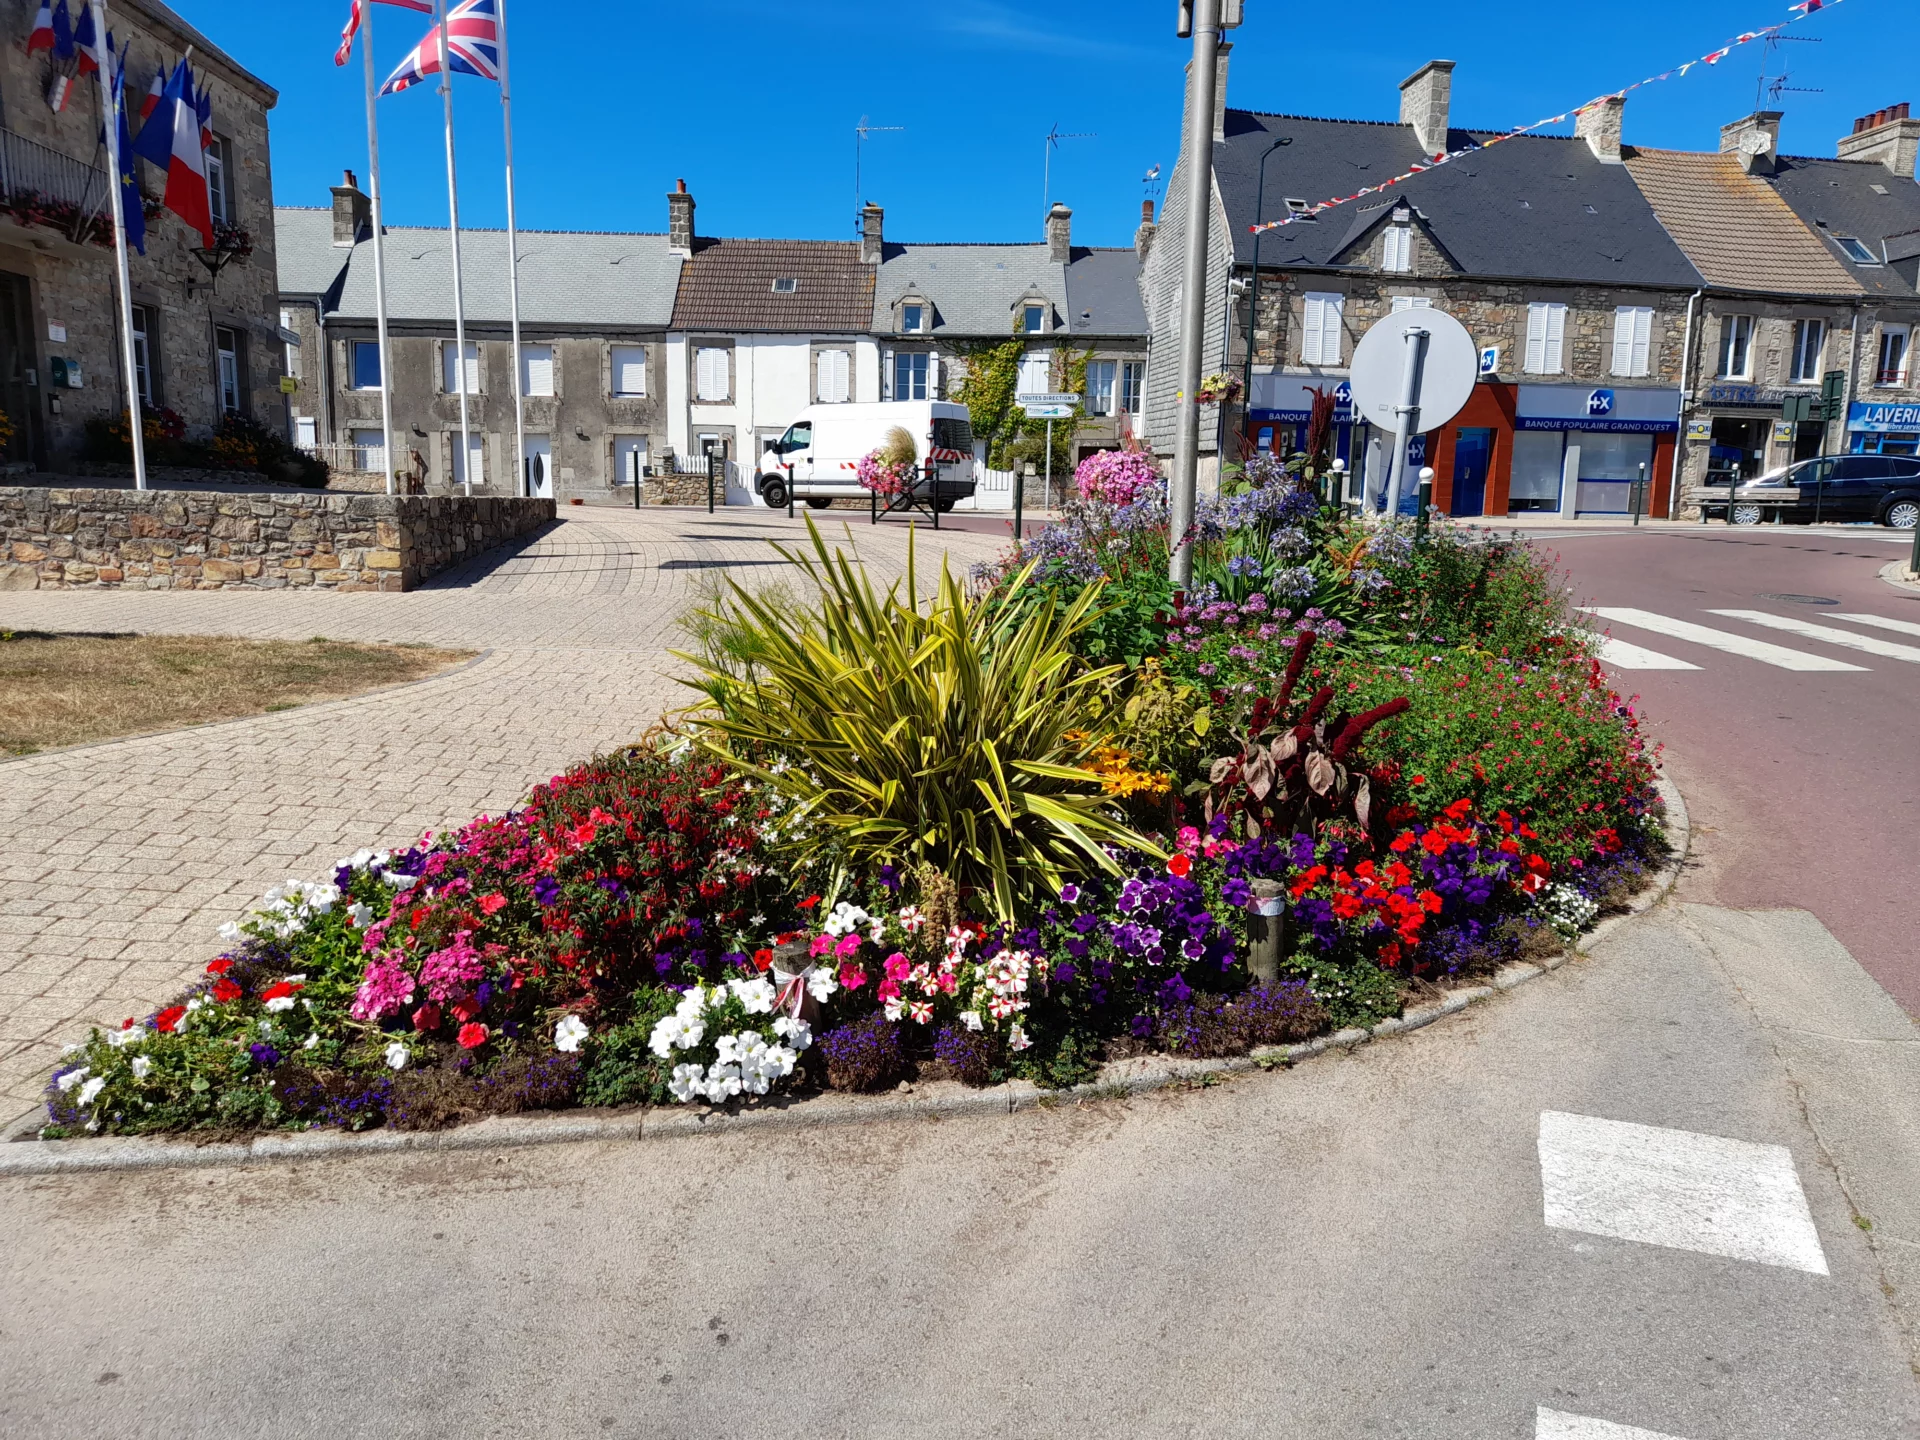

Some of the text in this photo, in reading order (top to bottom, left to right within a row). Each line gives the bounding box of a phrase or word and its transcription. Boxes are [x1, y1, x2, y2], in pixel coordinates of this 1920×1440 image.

[1268, 413, 1308, 421] BANQUE
[1525, 420, 1671, 431] BANQUE POPULAIRE GRAND OUEST
[1688, 424, 1710, 434] PROXI
